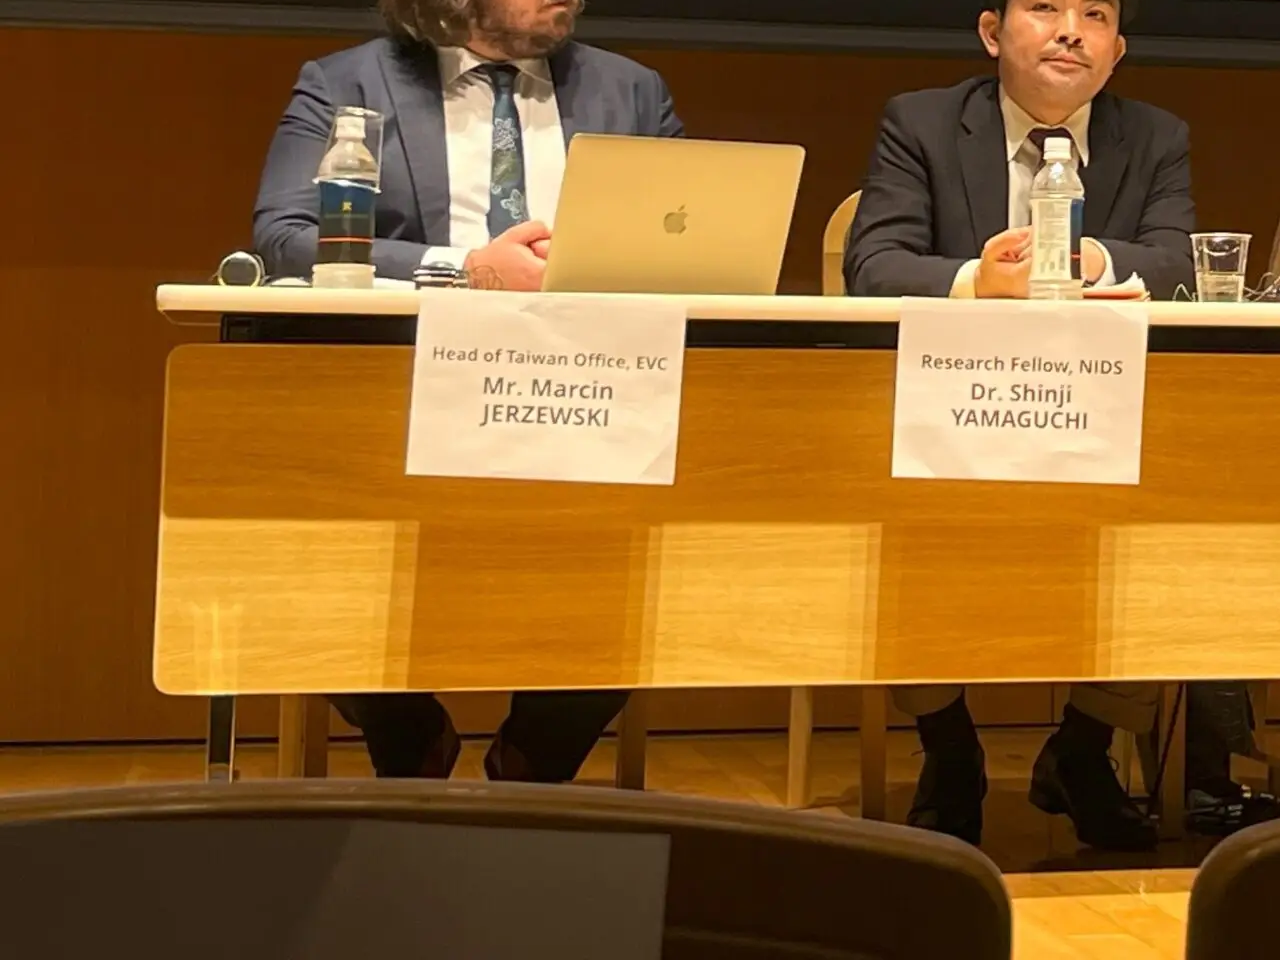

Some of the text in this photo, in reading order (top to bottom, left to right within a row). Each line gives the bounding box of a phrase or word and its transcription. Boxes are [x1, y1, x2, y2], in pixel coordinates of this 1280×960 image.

[432, 346, 669, 371] Head of Taiwan Office, EVC
[921, 354, 1123, 376] Research Fellow, NIDS
[483, 376, 614, 401] Mr. Marcin
[970, 383, 1072, 408] Dr. Shinji
[479, 403, 610, 428] JERZEWSKI
[951, 408, 1088, 430] YAMAGUCHI
